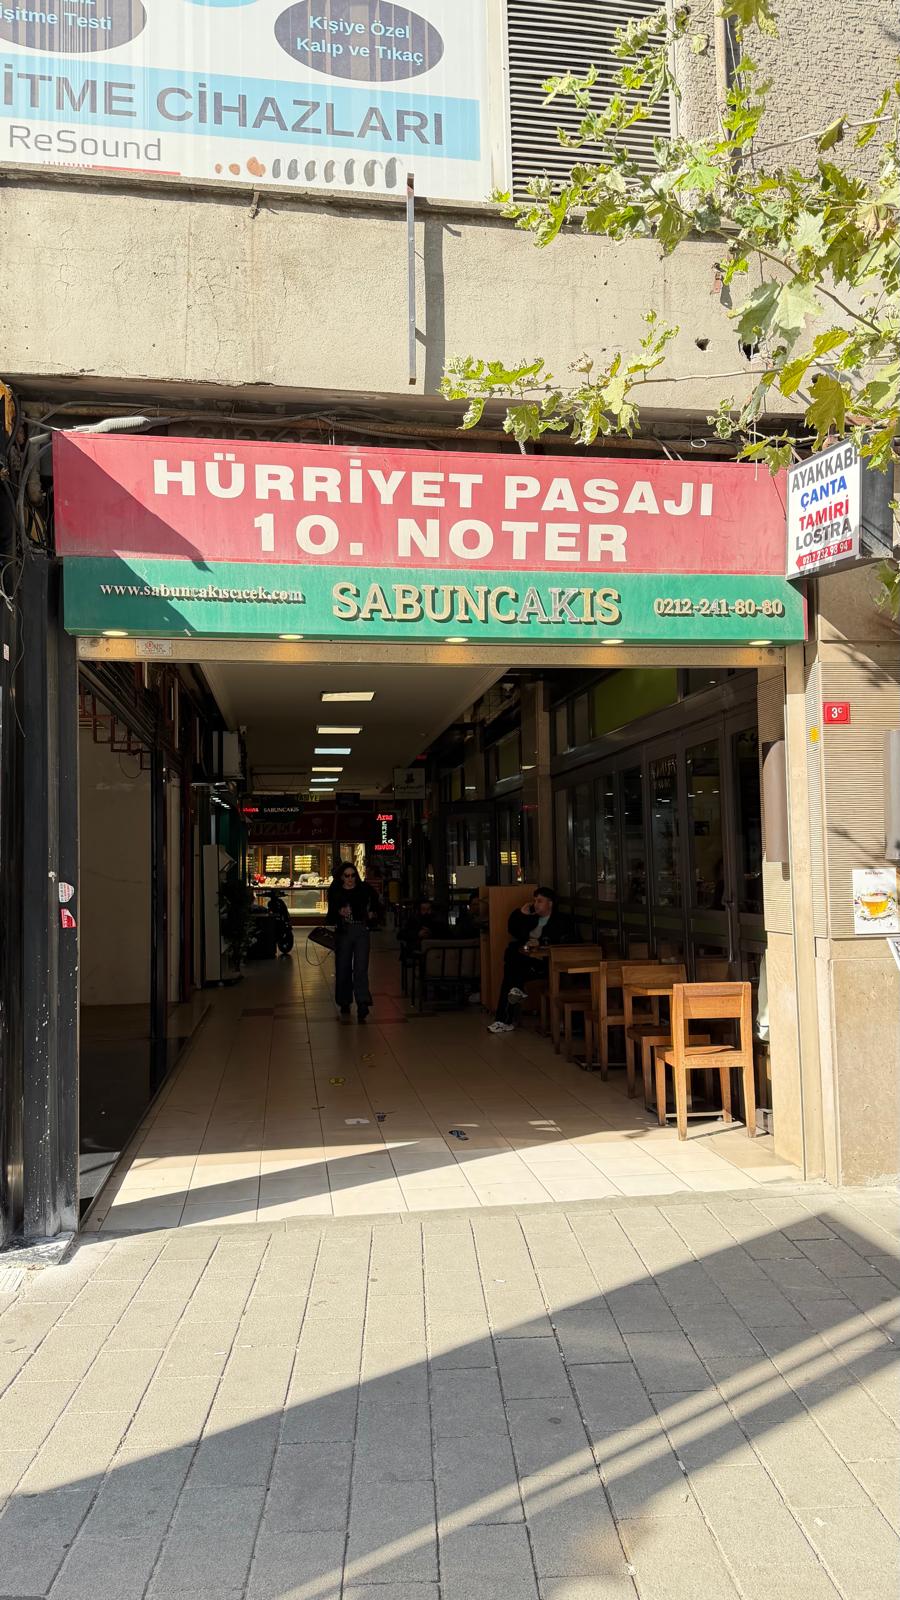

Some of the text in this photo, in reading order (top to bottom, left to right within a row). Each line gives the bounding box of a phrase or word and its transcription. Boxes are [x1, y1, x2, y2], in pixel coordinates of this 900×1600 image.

[64, 12, 112, 30] Testi
[309, 14, 410, 39] Kişiye Özel
[296, 37, 424, 66] Kalıp ve Tıkaç
[156, 82, 443, 146] CİHAZLARI
[9, 124, 162, 162] ReSound
[153, 452, 713, 516] HÜRRİYET PASAJI
[791, 445, 858, 493] AYAKKABI
[800, 475, 848, 512] ÇANTA
[799, 494, 850, 531] TAMİRİ
[253, 512, 628, 562] 10. NOTER
[796, 517, 852, 551] LOSTRA
[802, 553, 816, 564] 0212
[817, 548, 828, 560] 232
[331, 581, 621, 624] SABUNCAKIS
[653, 597, 784, 616] 0212-241-80-80
